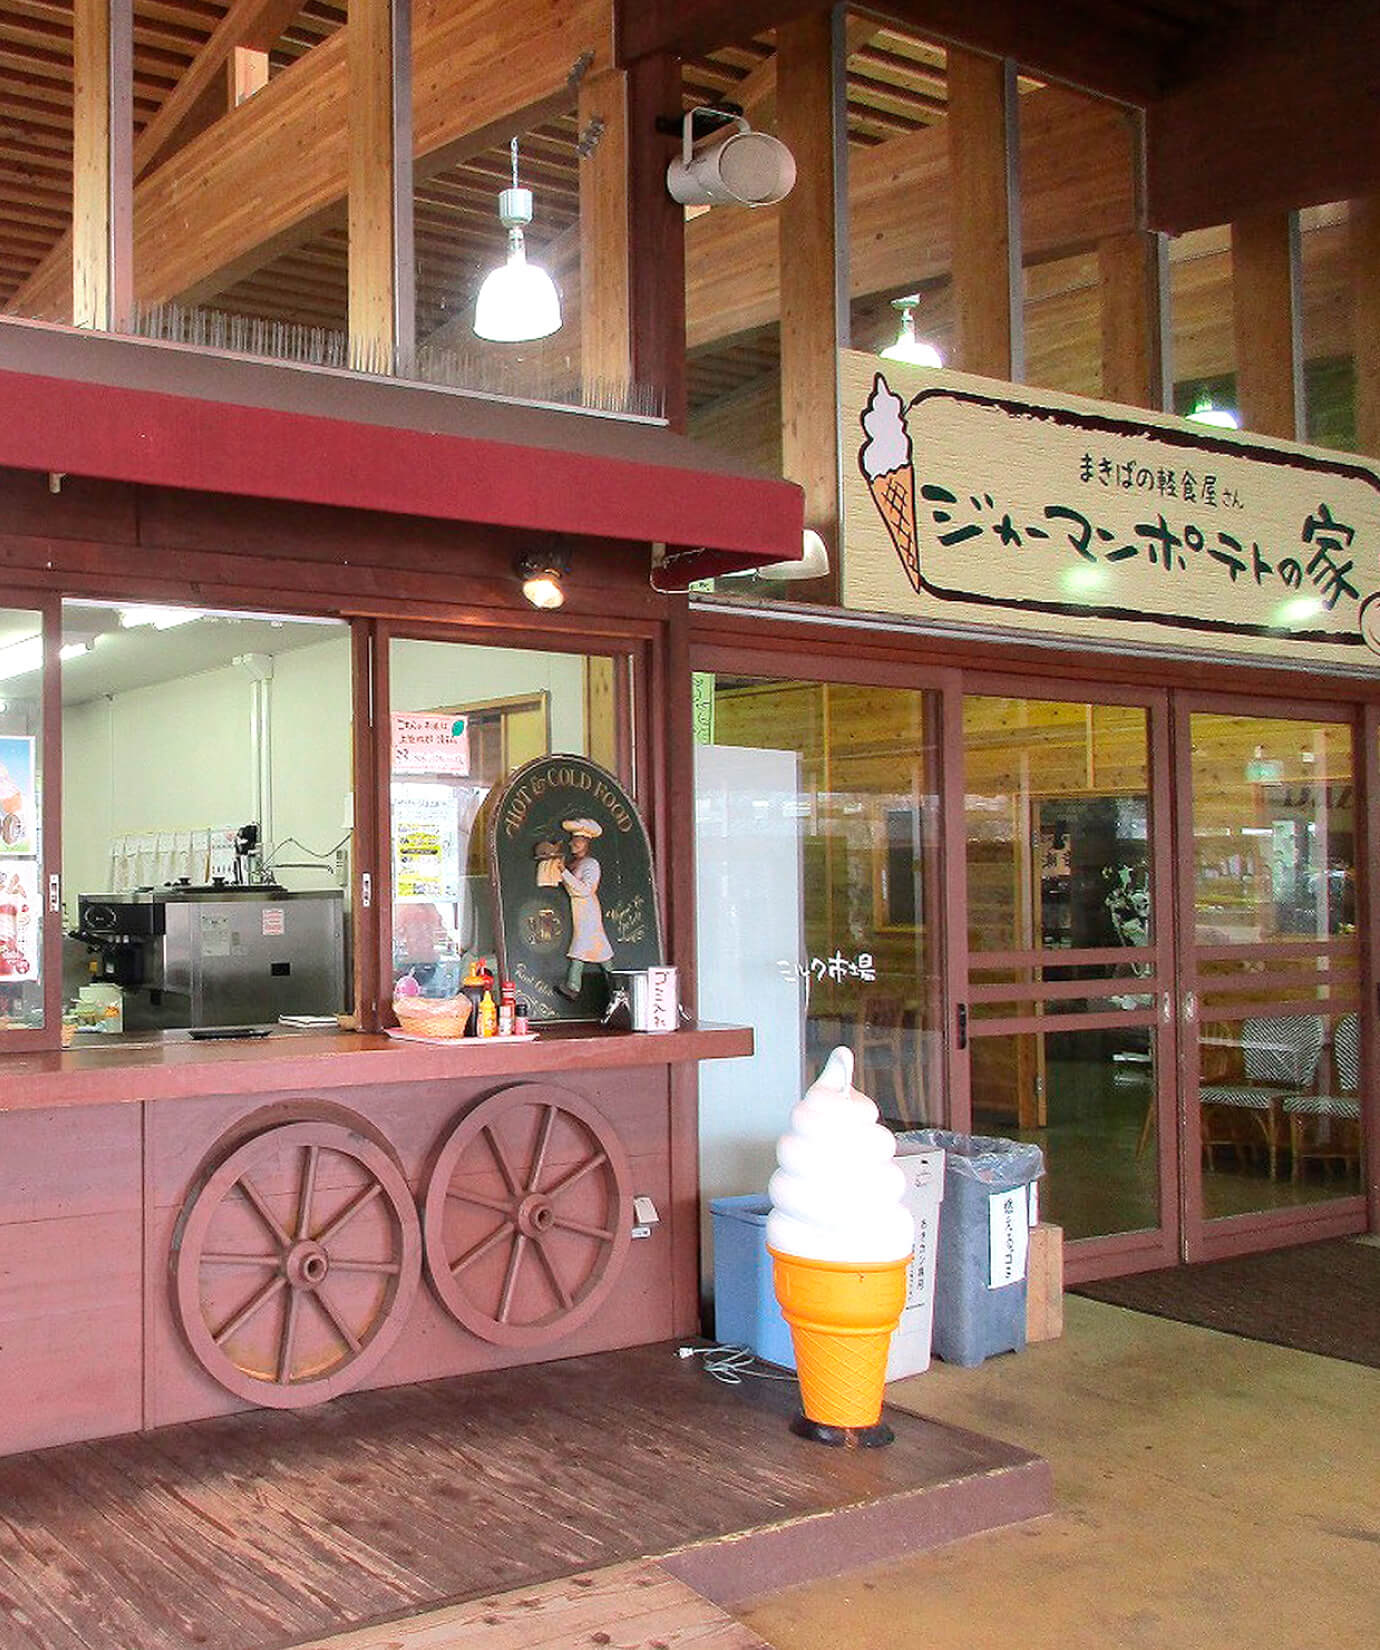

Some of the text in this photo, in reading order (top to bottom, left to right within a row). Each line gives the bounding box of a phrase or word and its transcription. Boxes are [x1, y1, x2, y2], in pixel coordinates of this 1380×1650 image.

[921, 484, 1361, 611] ジャーマンポテトの家
[505, 786, 532, 837] HOT
[547, 768, 592, 790] COLD
[594, 781, 633, 833] FOOD
[776, 949, 876, 984] ミルク市場
